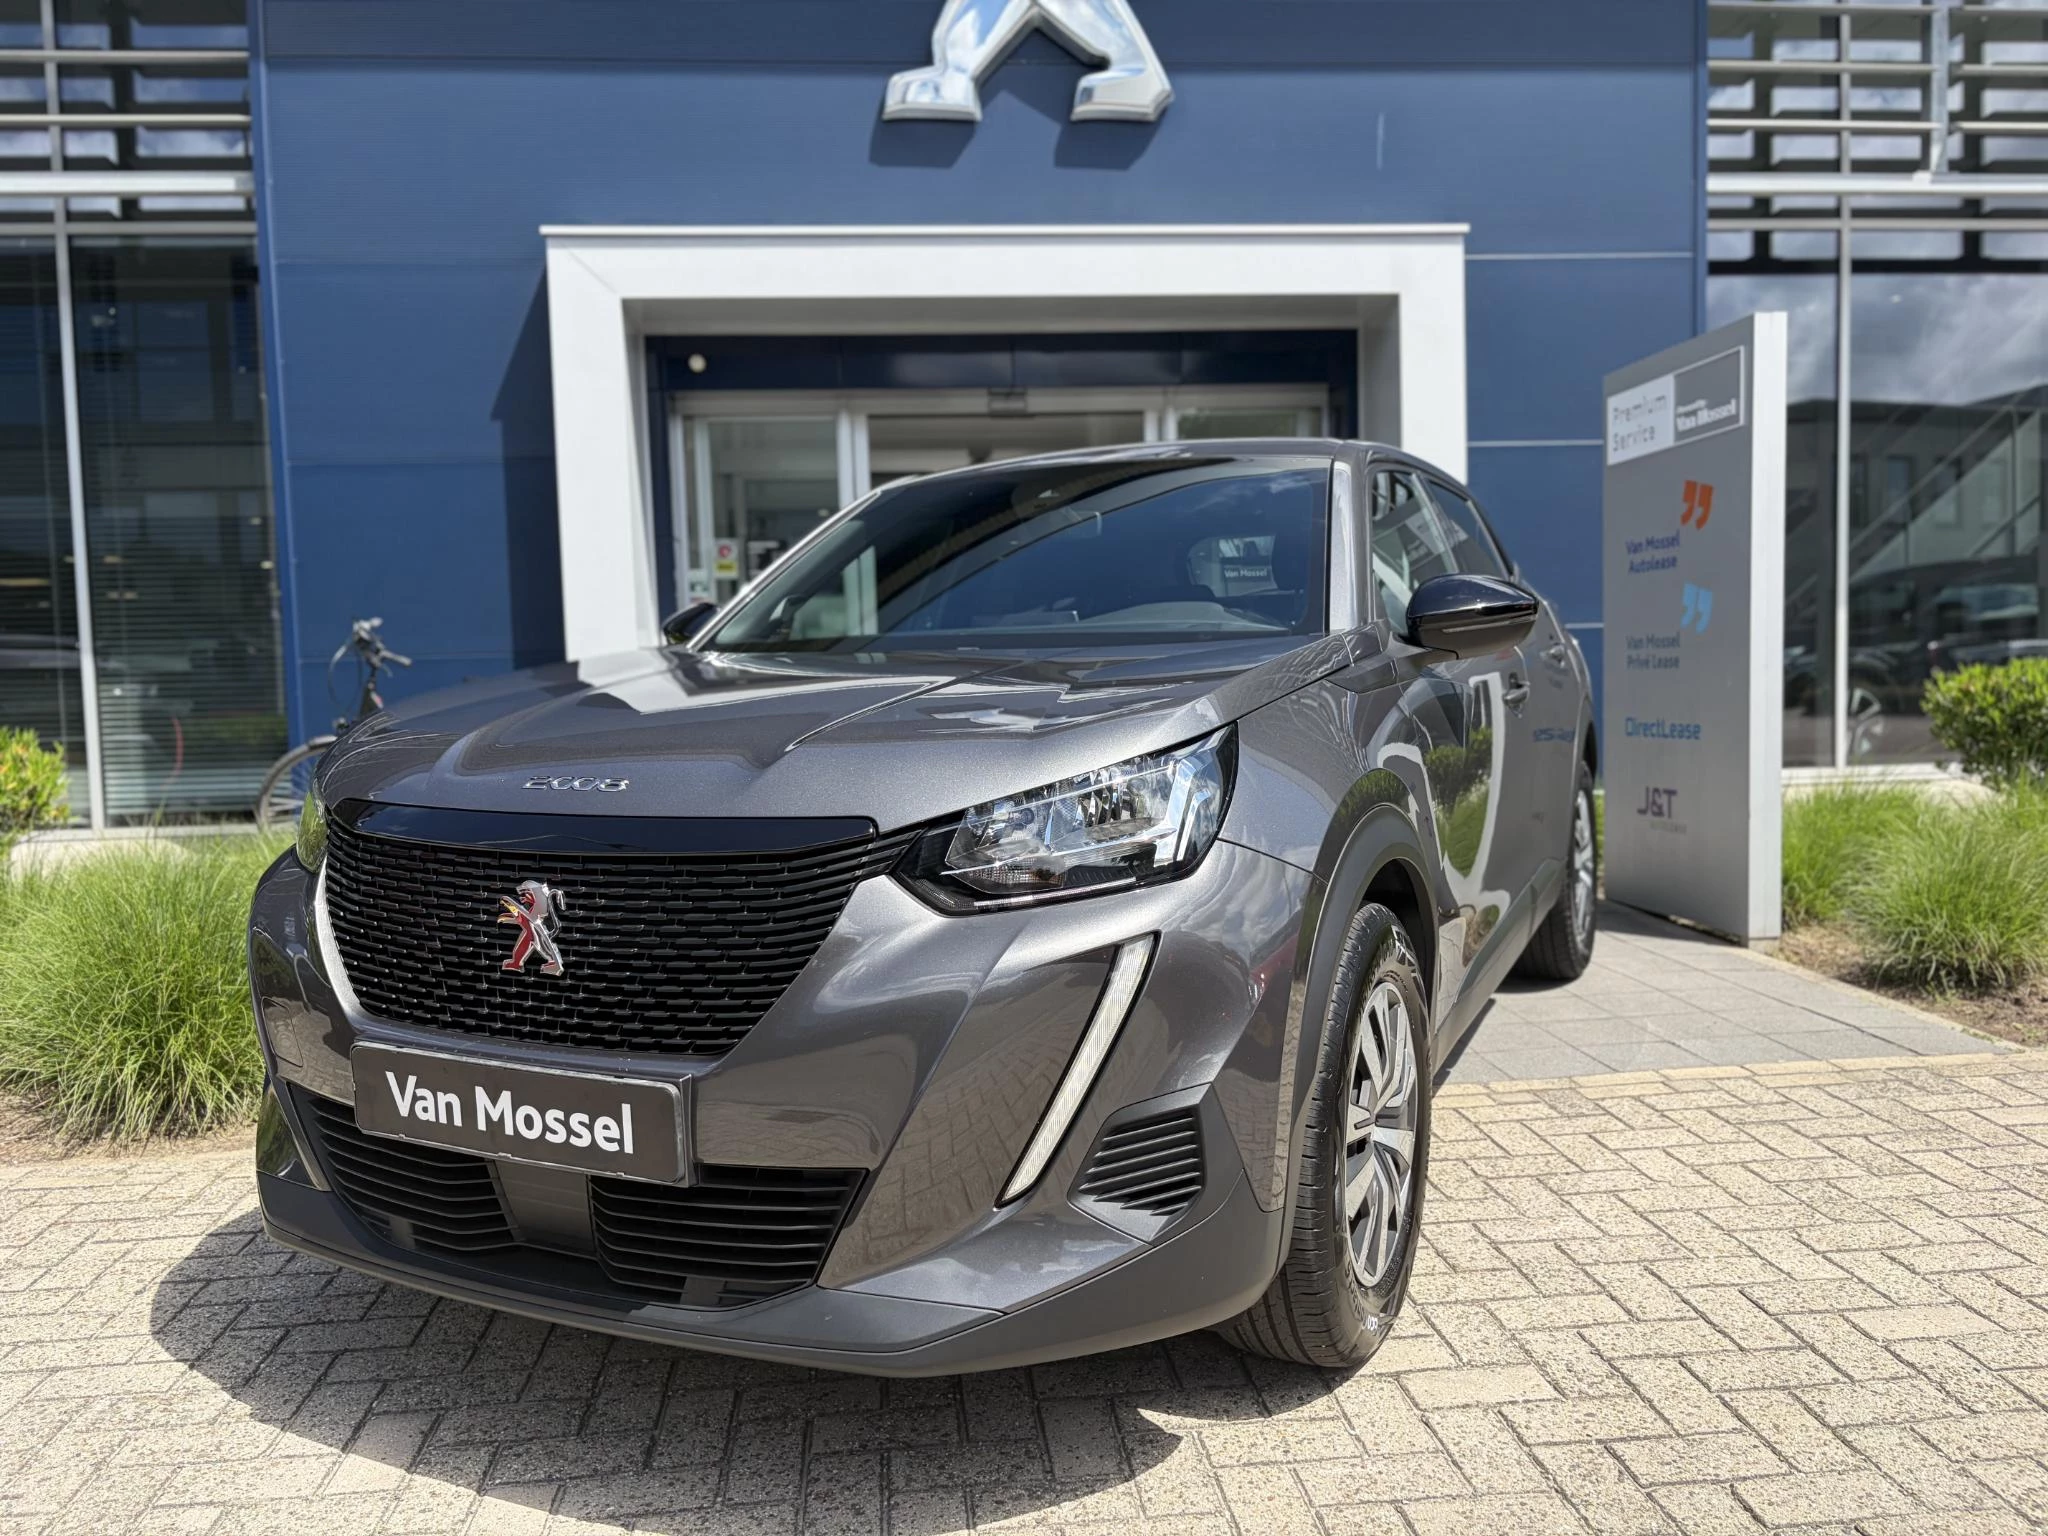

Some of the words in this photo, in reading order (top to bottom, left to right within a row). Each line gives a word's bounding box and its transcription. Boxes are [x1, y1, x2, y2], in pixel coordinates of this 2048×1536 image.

[1613, 425, 1656, 452] Service
[1626, 540, 1643, 554] Van
[1645, 530, 1680, 550] Mossel
[1224, 569, 1239, 577] Van
[1240, 568, 1267, 577] Mossel
[1628, 555, 1678, 574] Autolease
[1625, 635, 1643, 650] Van
[1645, 632, 1680, 649] Mossel
[1651, 654, 1680, 669] Lease
[1625, 717, 1702, 740] DirectLease
[522, 776, 629, 792] 2008
[1637, 786, 1678, 818] J&T
[385, 1071, 463, 1127] Van
[474, 1086, 634, 1154] Mossel
